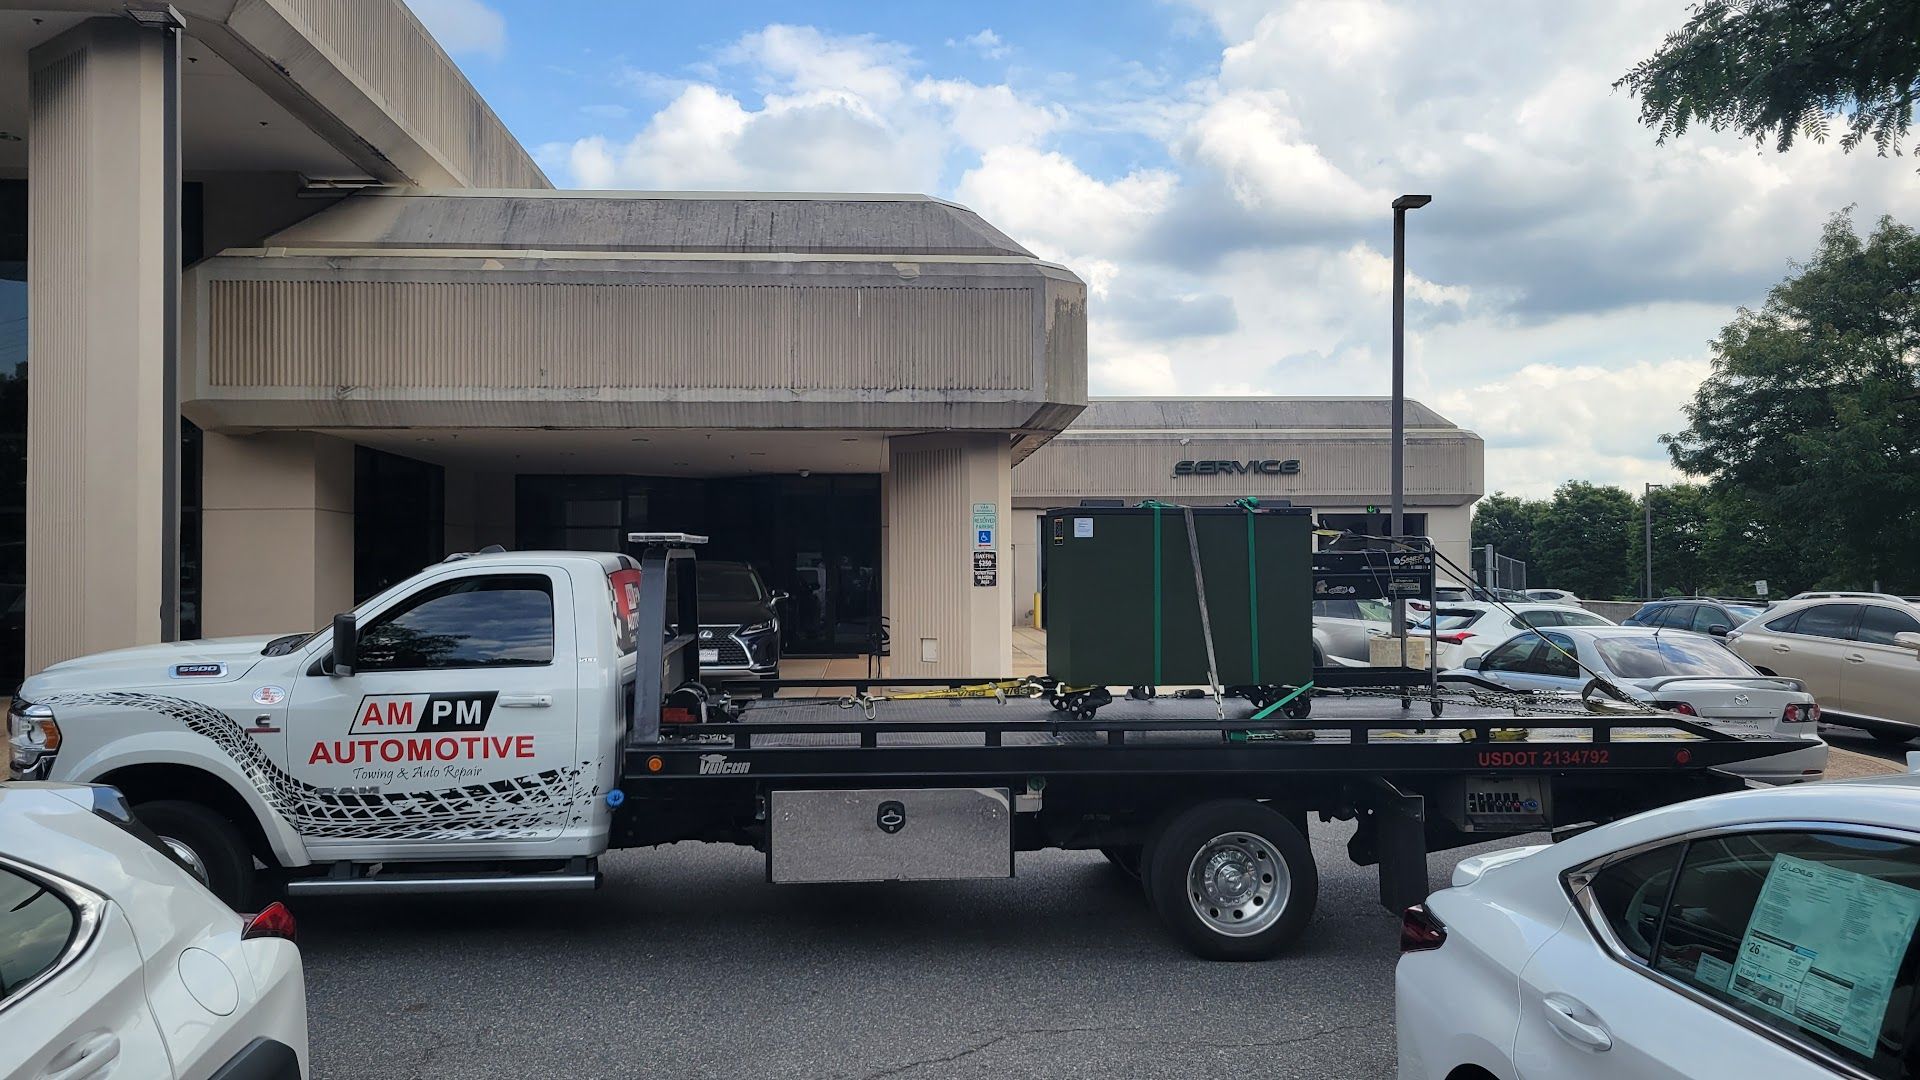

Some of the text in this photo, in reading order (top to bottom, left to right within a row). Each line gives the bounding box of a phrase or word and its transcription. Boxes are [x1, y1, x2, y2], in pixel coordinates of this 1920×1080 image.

[1174, 459, 1300, 475] SERVICE
[361, 700, 482, 726] AM PM
[308, 735, 535, 765] AUTOMOTIVE
[1478, 750, 1609, 767] USDOT 2134792
[700, 755, 750, 775] Vulcan
[353, 764, 482, 785] Towing & Auto Repair
[1788, 866, 1814, 878] LEXUS
[1749, 942, 1761, 955] 26
